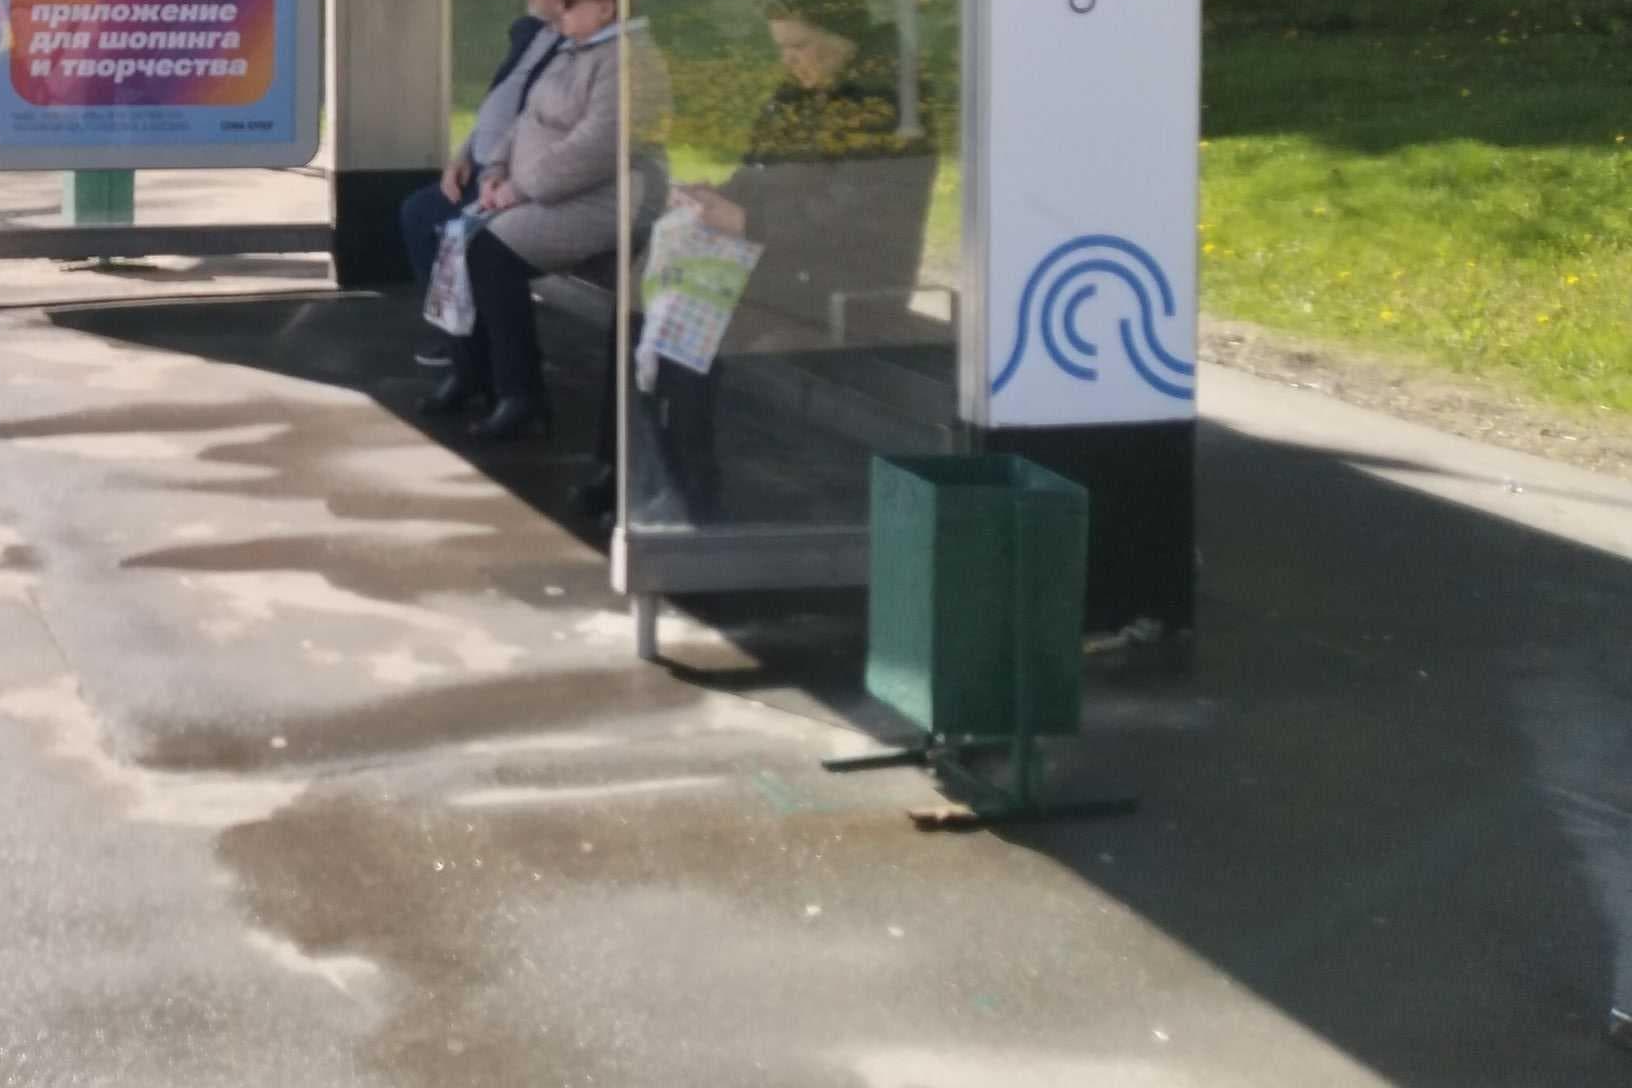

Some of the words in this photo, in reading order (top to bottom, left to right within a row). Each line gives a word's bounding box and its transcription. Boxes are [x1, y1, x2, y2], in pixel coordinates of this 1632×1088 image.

[31, 2, 238, 29] приложение
[29, 30, 91, 54] для
[98, 30, 241, 50] шопинга
[30, 58, 52, 77] и
[62, 58, 249, 84] творчества
